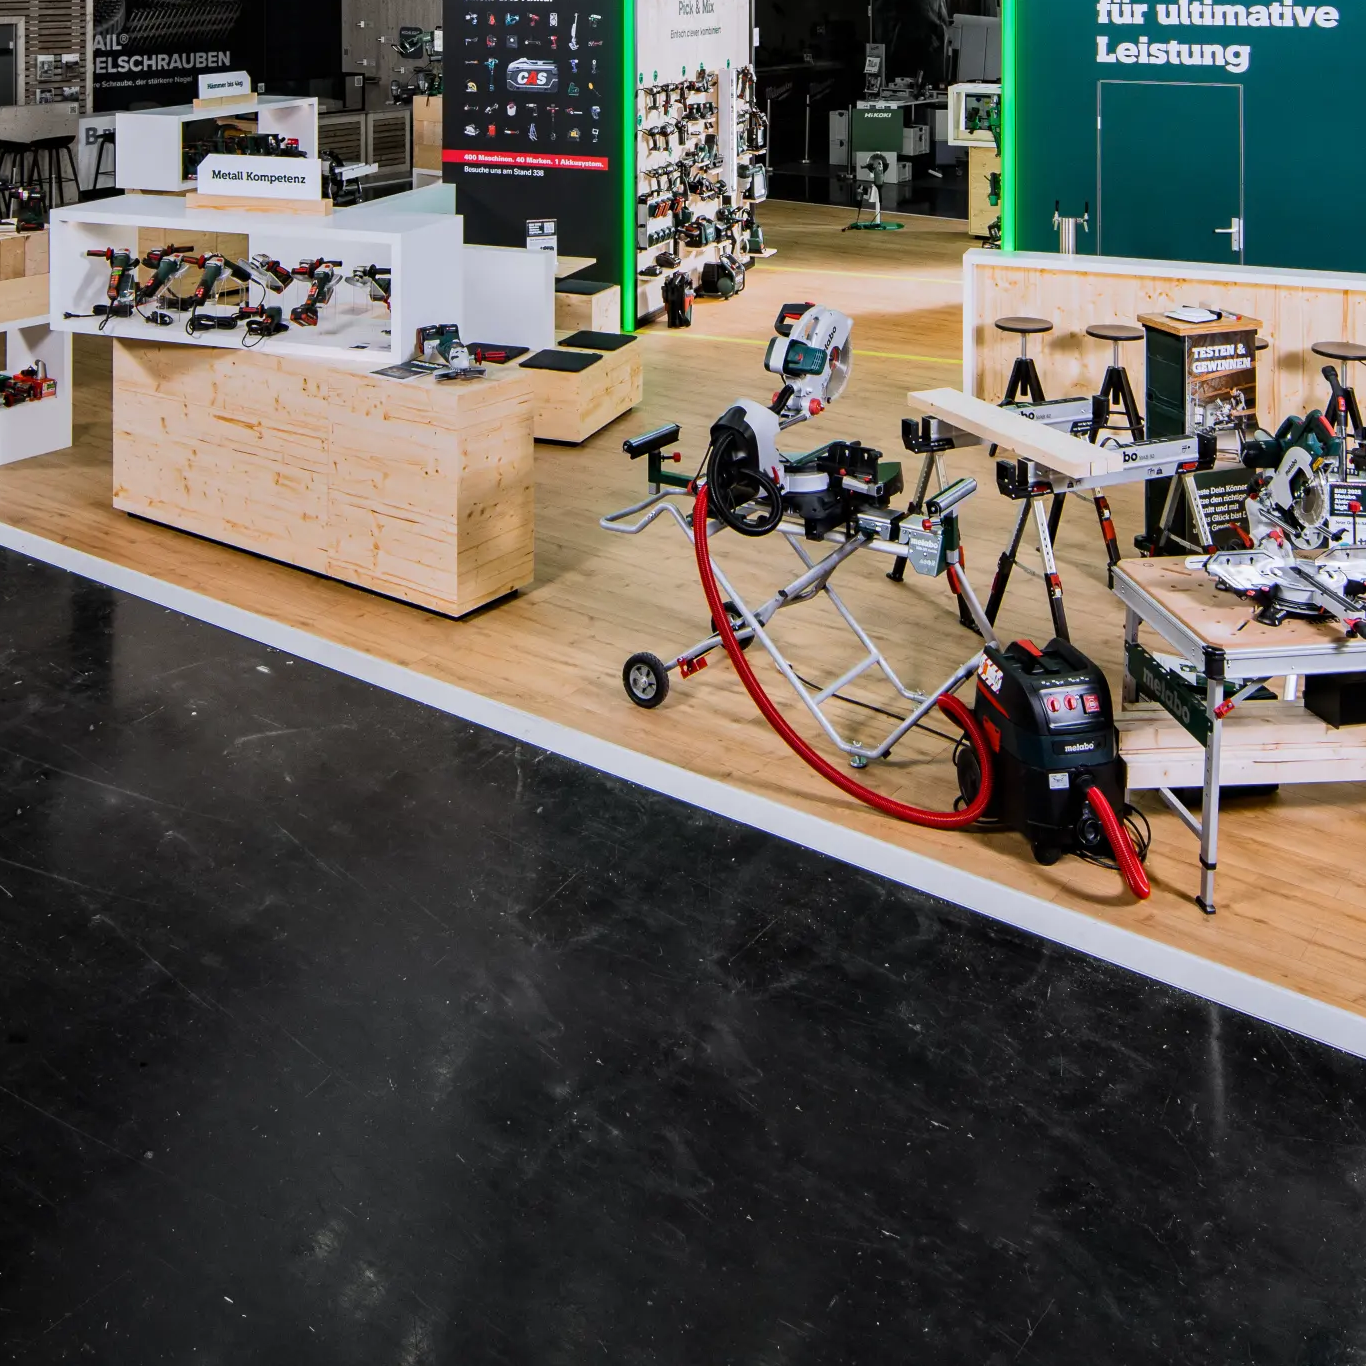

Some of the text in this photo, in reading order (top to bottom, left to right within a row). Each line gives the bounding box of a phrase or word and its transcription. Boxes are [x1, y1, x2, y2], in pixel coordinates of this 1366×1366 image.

[678, 0, 694, 16] Pick
[695, 0, 701, 15] &
[1096, 36, 1251, 73] Leistung
[92, 51, 231, 75] ELSCHRAUBEN
[102, 79, 135, 89] Schraube,
[175, 76, 193, 85] Nagel
[517, 70, 548, 86] CAS
[478, 155, 515, 163] Maschinen.
[526, 157, 553, 165] Marken.
[560, 159, 604, 168] Akkusystem.
[212, 170, 306, 185] Metall Kompetenz
[464, 165, 489, 174] Besuche
[514, 168, 532, 176] Stand
[1192, 343, 1246, 359] TESTEN &
[1192, 357, 1252, 373] GEWINNEN
[1213, 494, 1222, 502] den
[1215, 504, 1228, 513] und
[1212, 511, 1242, 523] Glück bist
[1143, 667, 1191, 725] metabo
[1064, 743, 1094, 752] metabo
